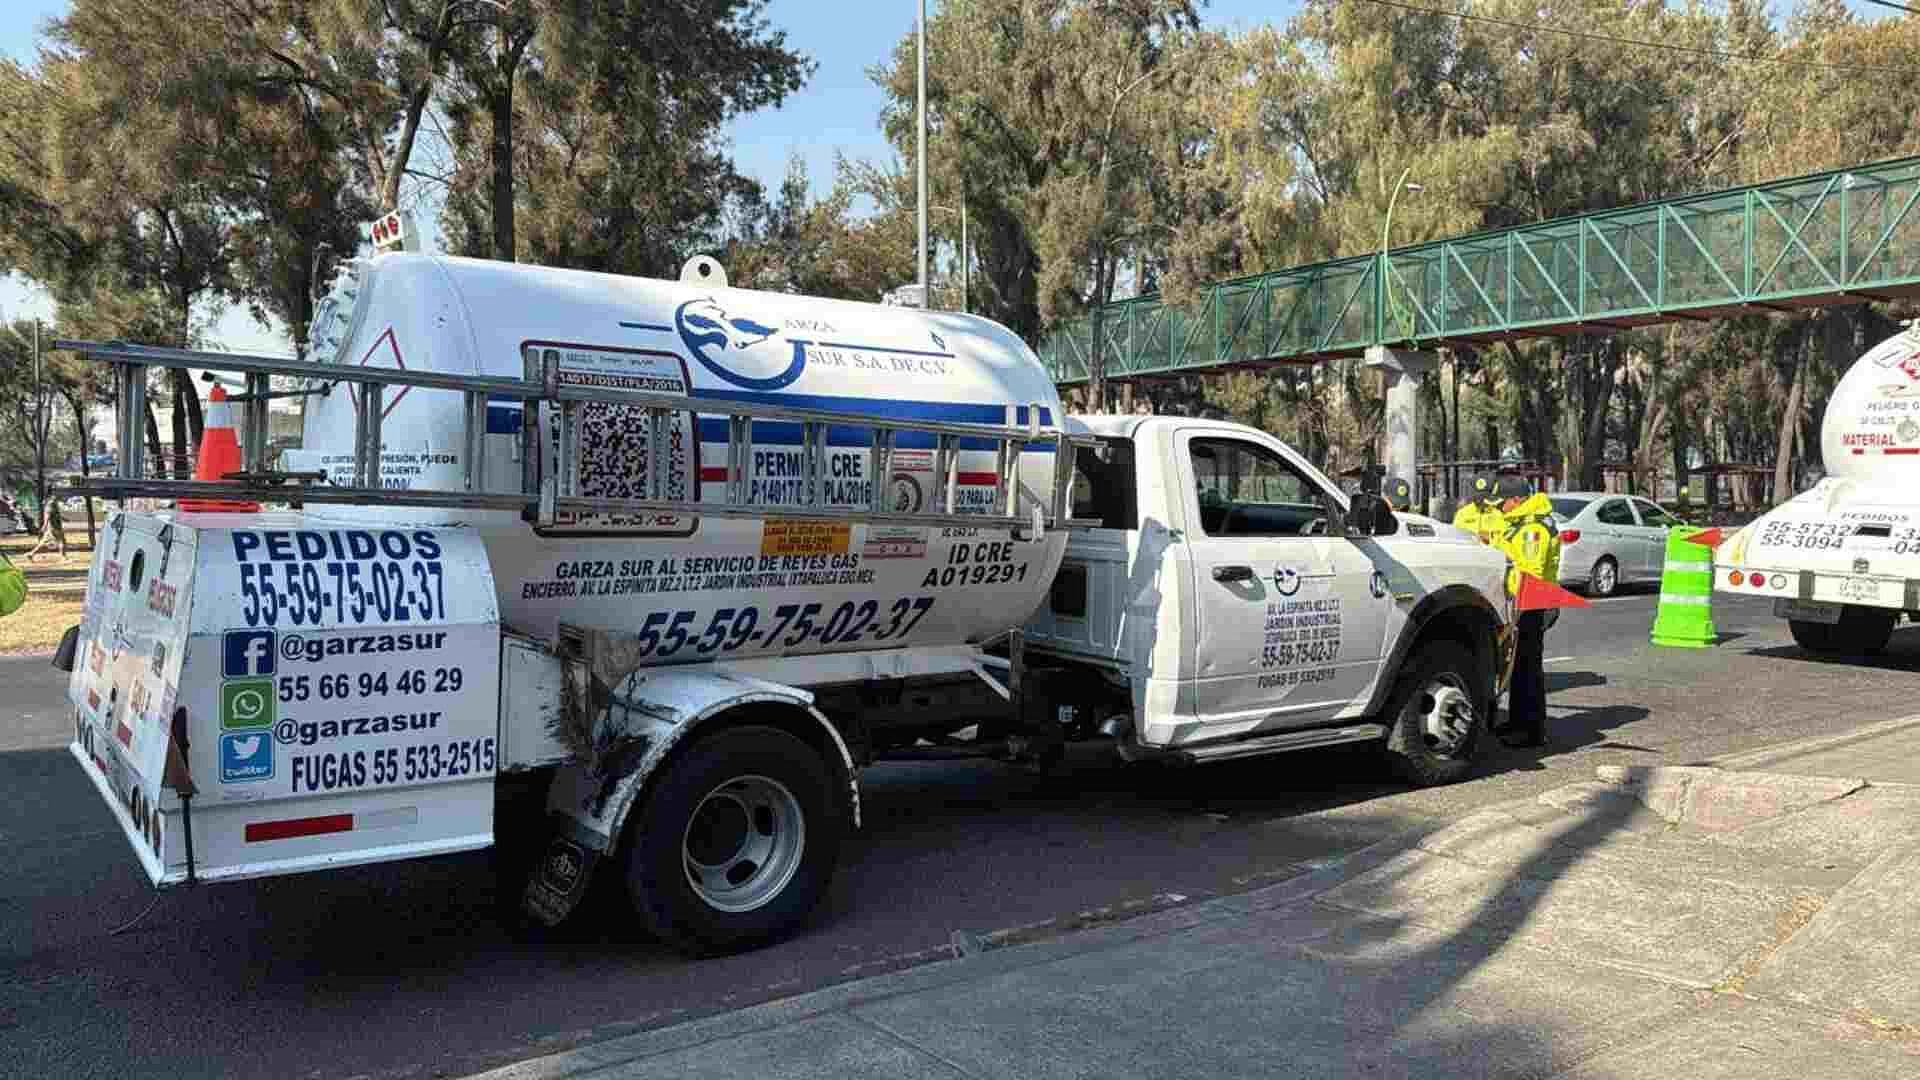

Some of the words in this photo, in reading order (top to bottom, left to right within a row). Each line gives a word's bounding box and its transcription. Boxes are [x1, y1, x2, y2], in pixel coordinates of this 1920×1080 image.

[808, 351, 847, 367] SUR
[1841, 433, 1897, 446] MATERIAL
[754, 451, 828, 477] PERMI
[831, 454, 862, 477] CRE
[1841, 512, 1910, 523] PEDIDOS
[232, 530, 442, 562] PEDIDOS
[948, 543, 970, 564] ID
[974, 542, 1014, 563] CRE
[1760, 533, 1843, 549] 55-3094
[556, 561, 614, 579] GARZA
[619, 560, 654, 577] SUR
[657, 558, 678, 575] AL
[682, 556, 754, 574] SERVICIO
[758, 554, 777, 572] DE
[781, 554, 826, 571] REYES
[831, 553, 859, 569] GAS
[920, 562, 1028, 588] A019291
[240, 559, 446, 626] 55-59-75-02-37
[639, 597, 935, 657] 55-59-75-02-37
[1296, 613, 1341, 627] INDUSTRIAL
[281, 631, 448, 662] @garzasur
[278, 675, 310, 702] 55
[319, 673, 350, 700] 66
[358, 671, 389, 698] 94
[396, 670, 427, 695] 46
[433, 667, 463, 693] 29
[274, 711, 442, 745] @garzasur
[225, 765, 268, 777] twitter
[291, 750, 366, 792] FUGAS
[373, 748, 398, 784] 55
[404, 738, 495, 781] 533-2515
